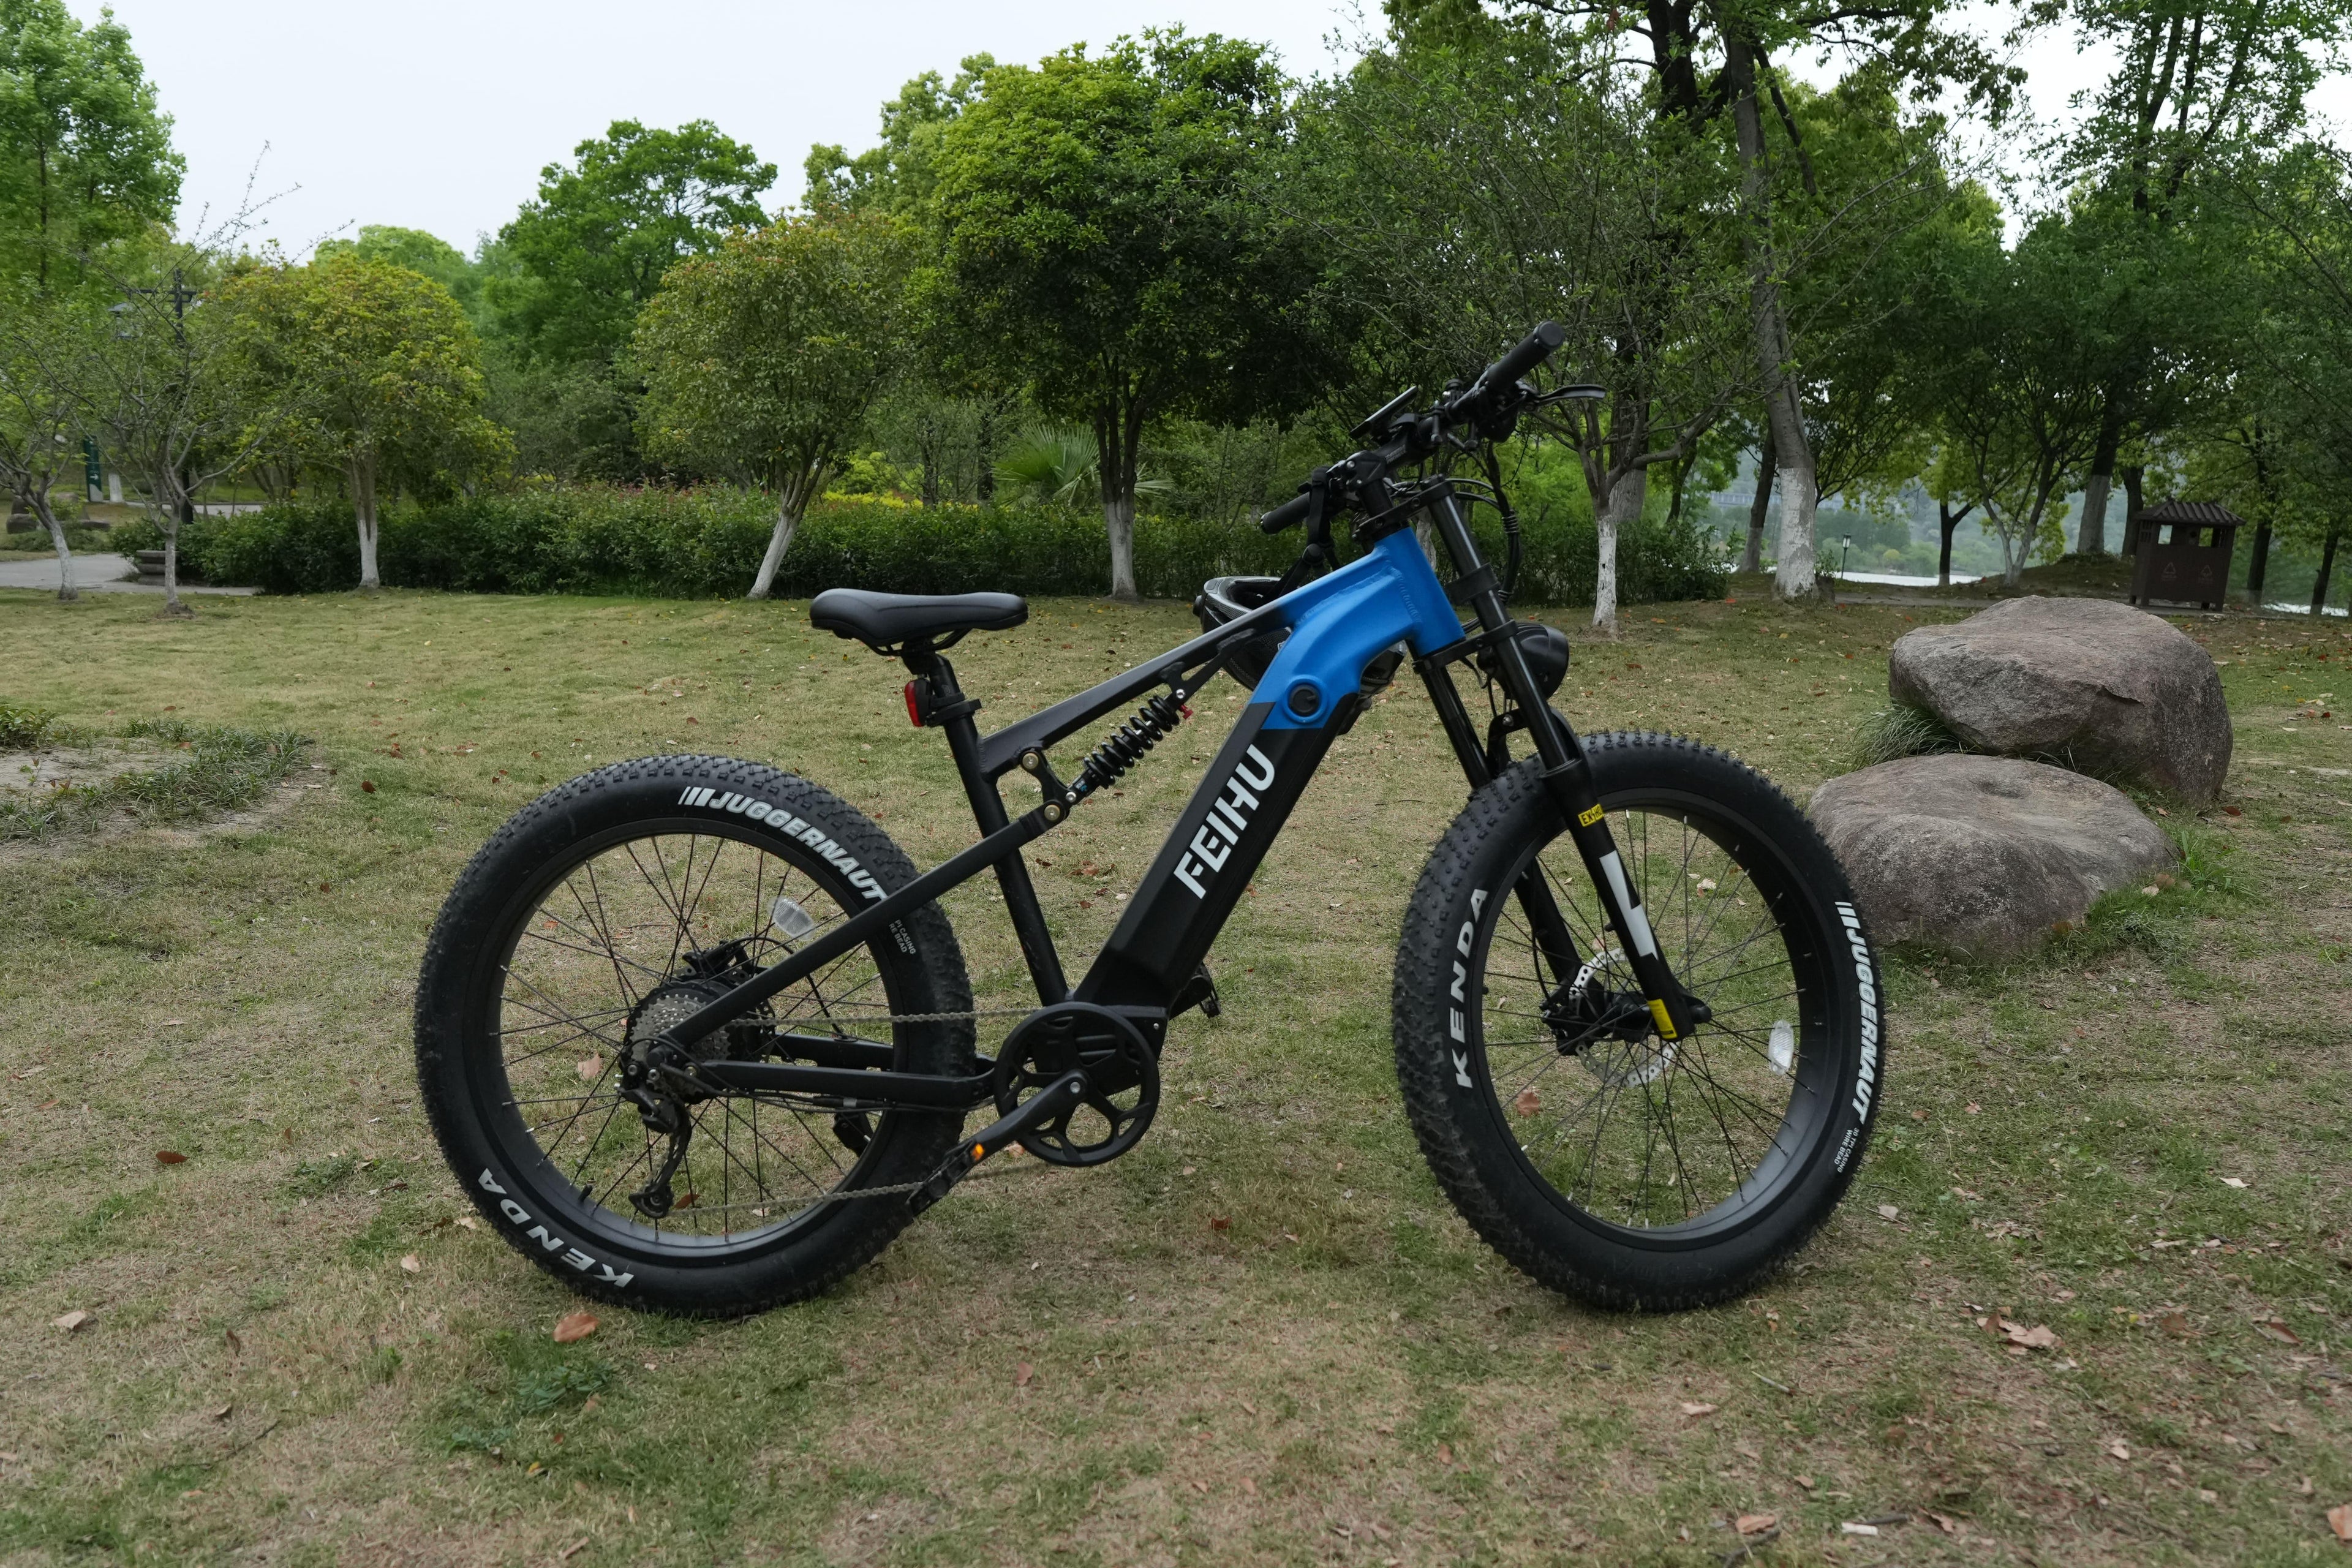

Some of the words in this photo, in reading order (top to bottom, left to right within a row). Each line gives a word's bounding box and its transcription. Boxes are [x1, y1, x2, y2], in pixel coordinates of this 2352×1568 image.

[1173, 744, 1275, 900] FEIHU
[708, 791, 888, 902] JUGGERNAUT
[889, 923, 898, 933] RE
[894, 933, 908, 952] BEAD
[899, 927, 916, 954] CASING
[1450, 889, 1488, 1088] KENDA
[1845, 928, 1878, 1125] JUGGERNAUT
[1842, 1129, 1853, 1148] WIRE
[1853, 1128, 1859, 1136] 30
[1834, 1147, 1846, 1165] BEAD
[1837, 1148, 1852, 1173] CASING
[478, 1167, 635, 1287] KENDA
